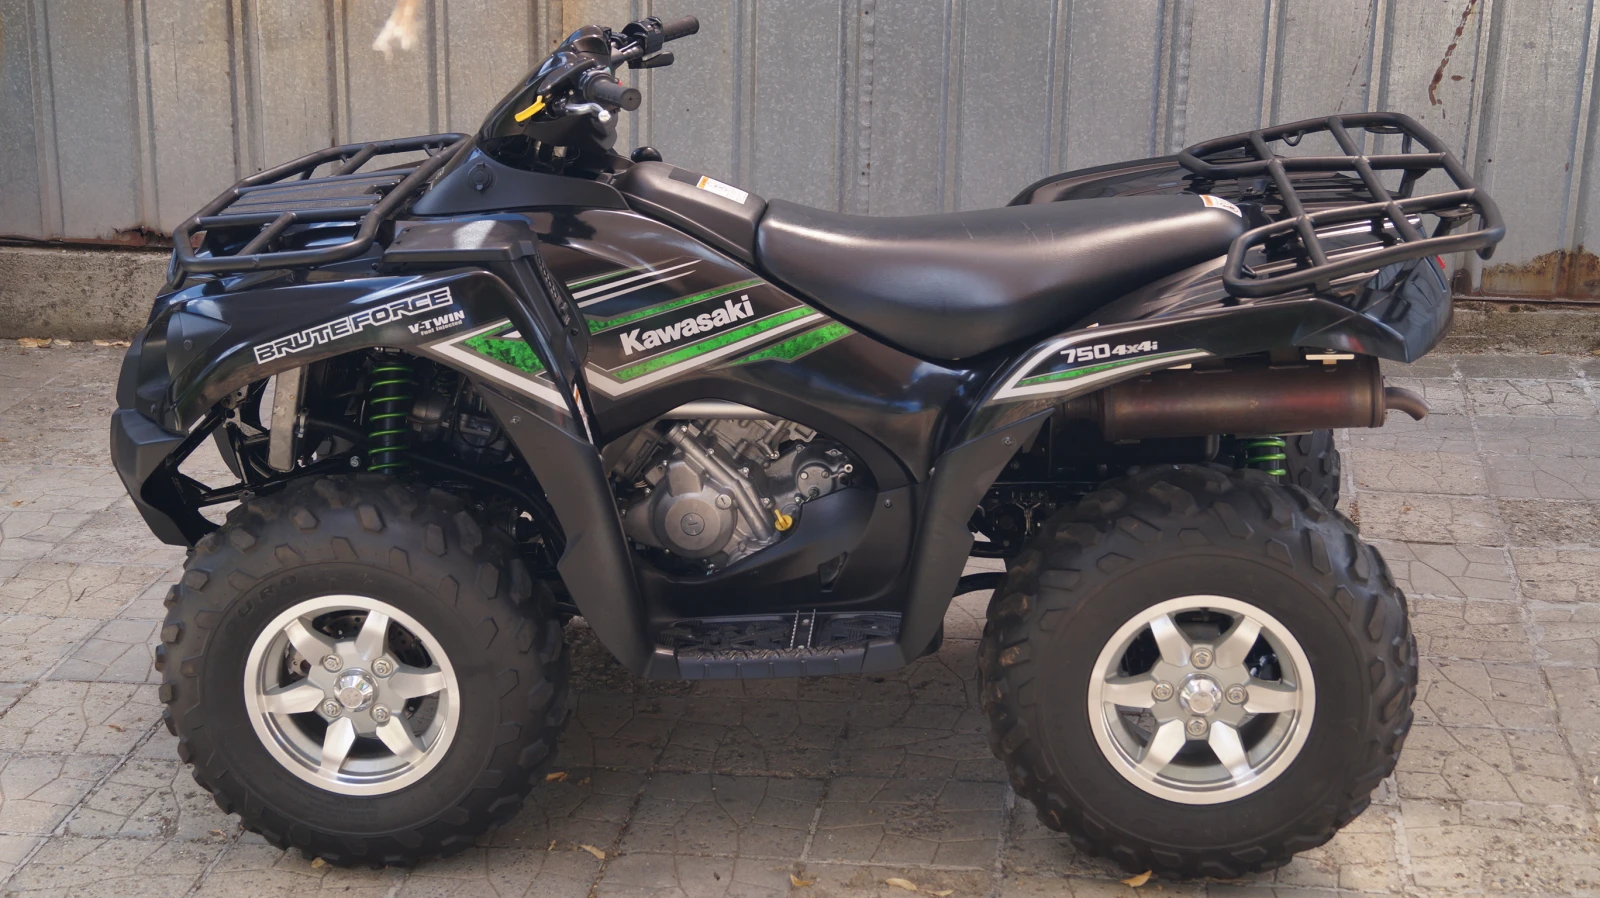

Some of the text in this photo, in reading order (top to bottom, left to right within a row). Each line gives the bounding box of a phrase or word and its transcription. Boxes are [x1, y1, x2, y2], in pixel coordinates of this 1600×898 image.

[253, 286, 454, 365] BRUTE FORCE
[408, 309, 465, 334] V-TWIN
[619, 294, 755, 356] Kawasaki
[1060, 340, 1158, 364] 750 4x4i
